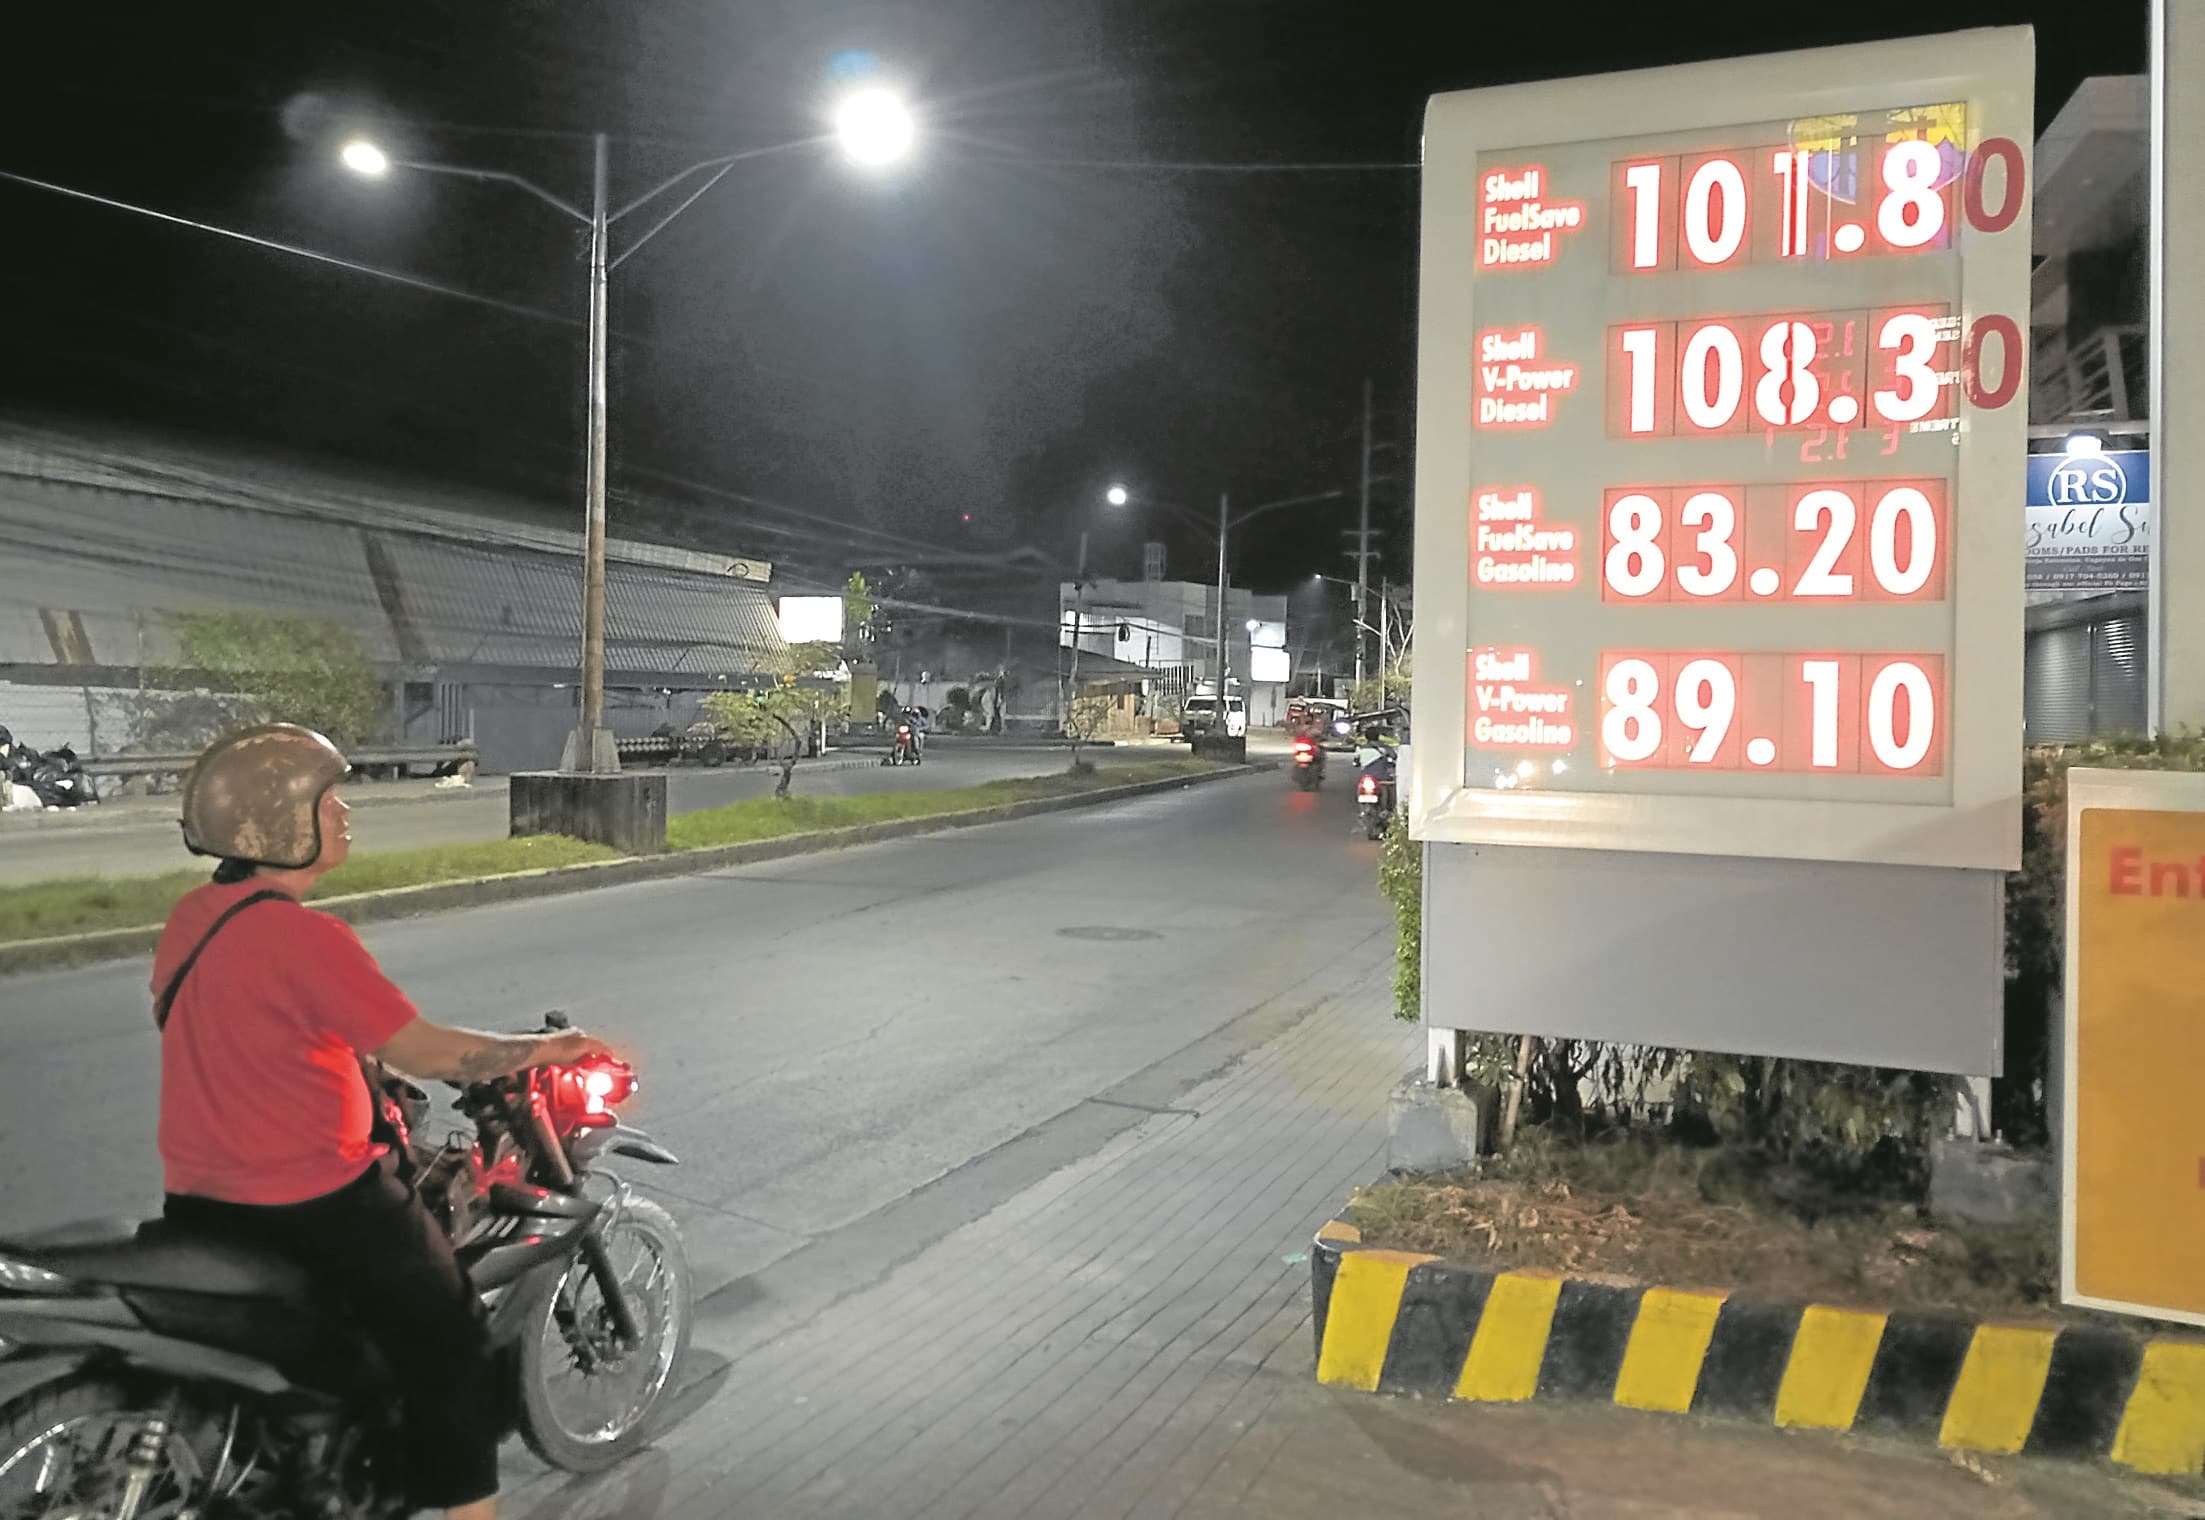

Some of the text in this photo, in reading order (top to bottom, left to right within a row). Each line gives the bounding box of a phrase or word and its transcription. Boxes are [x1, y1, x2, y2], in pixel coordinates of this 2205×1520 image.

[1485, 171, 1539, 203] Shell
[1484, 203, 1581, 234] FuelSave
[1483, 234, 1551, 265] Diesel
[1482, 332, 1536, 362] Shell
[1482, 365, 1574, 393] V-Power
[1480, 395, 1548, 424] Diesel
[2057, 468, 2119, 504] RS
[1478, 493, 1533, 521] Shell
[1478, 525, 1574, 554] FuelSave
[1603, 487, 1938, 597] 83.20
[2103, 544, 2129, 553] FOR
[1478, 555, 1574, 585] Gasoline
[1476, 653, 1530, 682] Shell
[1476, 686, 1568, 714] V-Power
[1601, 658, 1935, 769] 89.10
[1475, 716, 1572, 746] Gasoline
